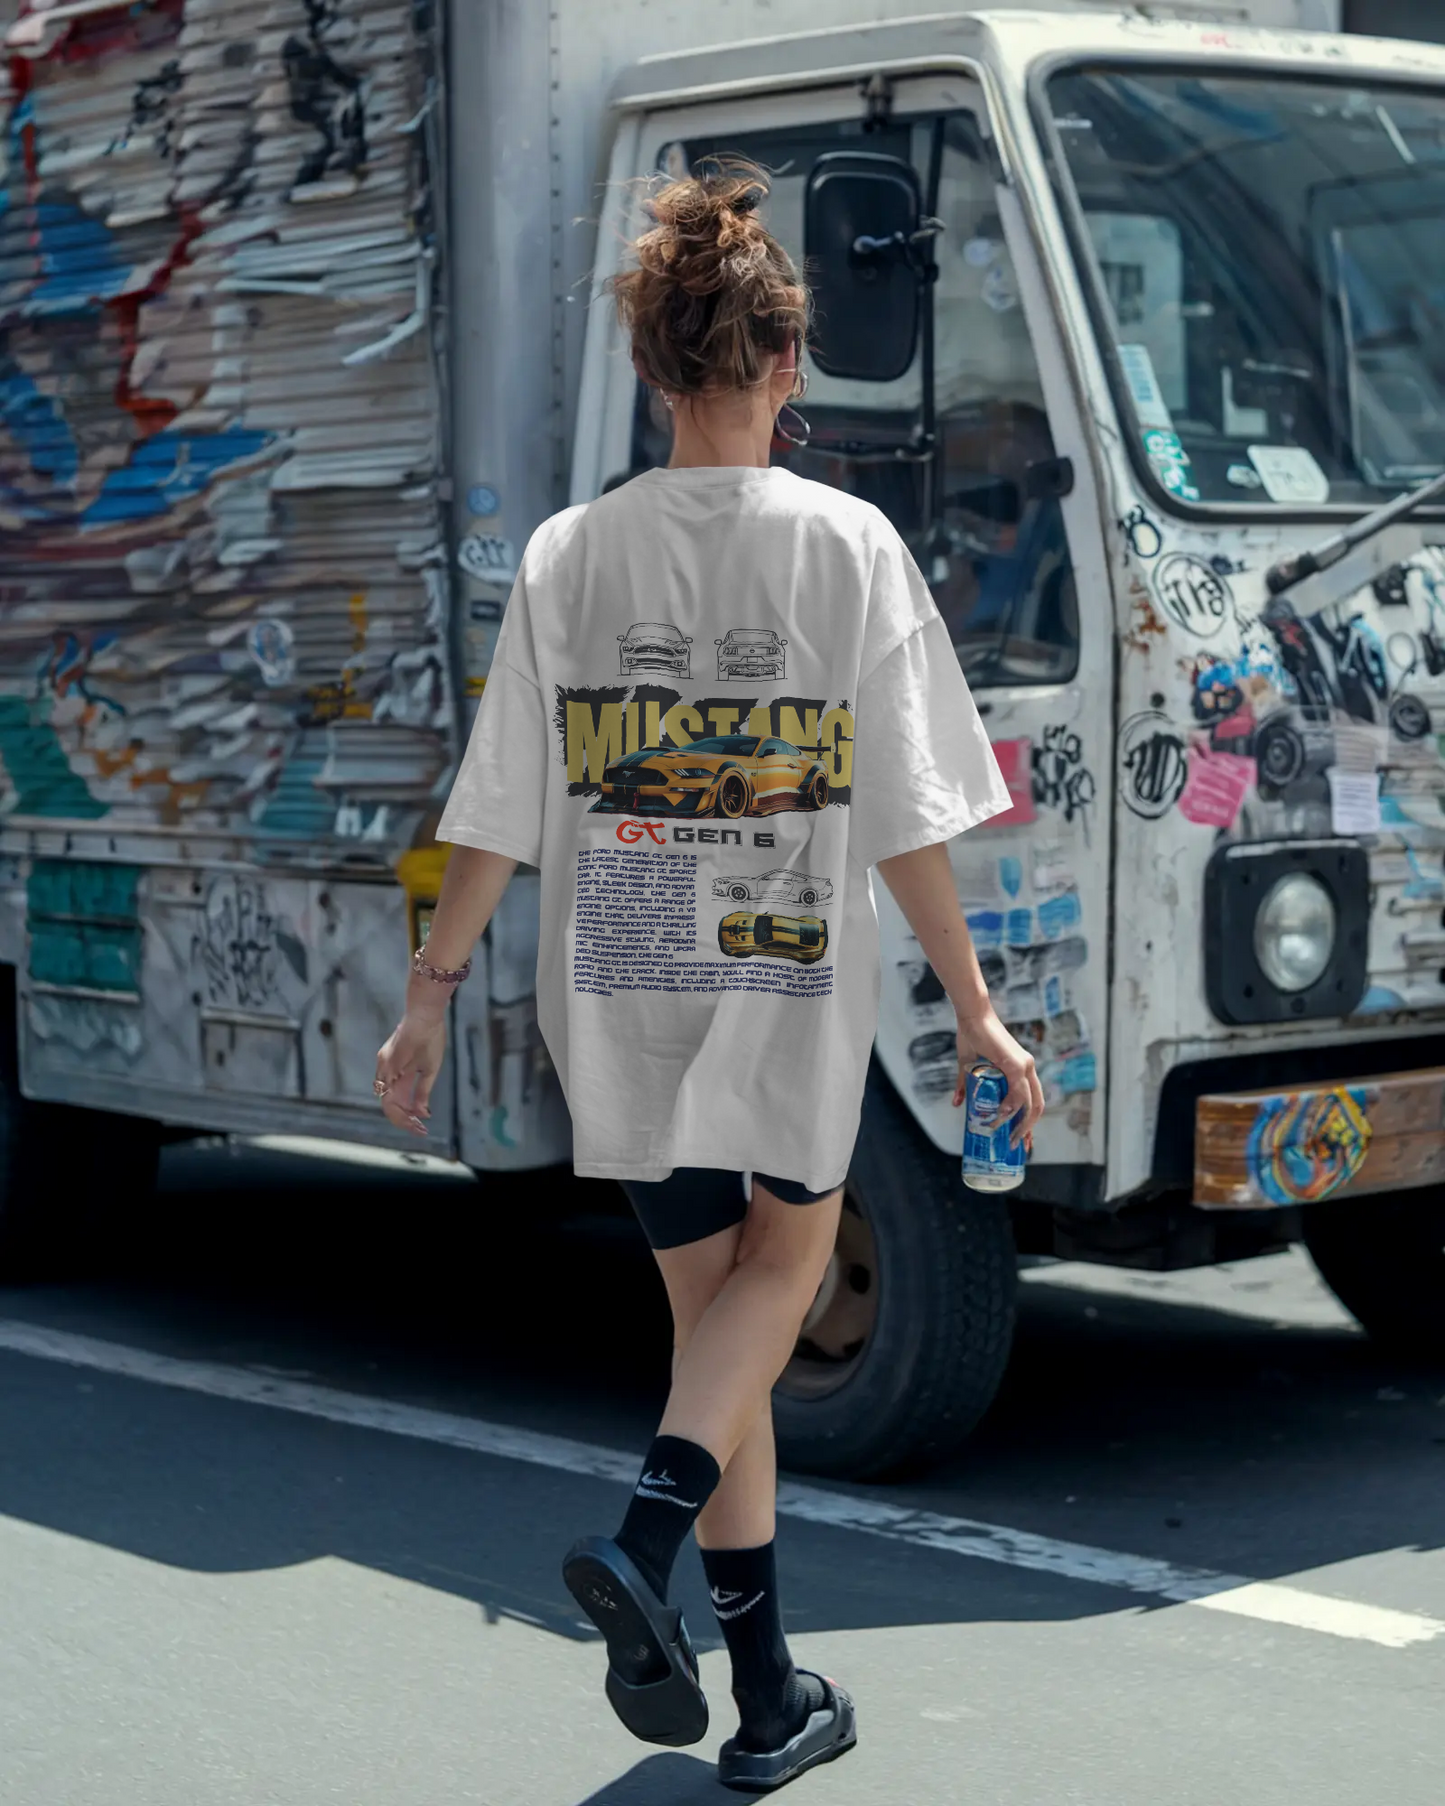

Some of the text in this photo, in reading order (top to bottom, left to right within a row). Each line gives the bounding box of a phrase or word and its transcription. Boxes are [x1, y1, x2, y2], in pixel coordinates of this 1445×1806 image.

[616, 820, 776, 849] GT GEN 6
[622, 858, 668, 867] GENERATION
[620, 865, 655, 873] MUSTANG
[604, 872, 645, 880] FEATURES
[587, 919, 642, 927] PERFORMANCE
[576, 934, 622, 942] AGGRESSIVE
[574, 956, 610, 965] MUSTANG
[737, 962, 792, 972] PERFORMANCE
[574, 971, 615, 981] FEATURES
[729, 977, 781, 986] TOUCHSCREEN
[773, 972, 795, 980] HOST
[809, 973, 833, 982] MODERN
[817, 989, 832, 997] TECH
